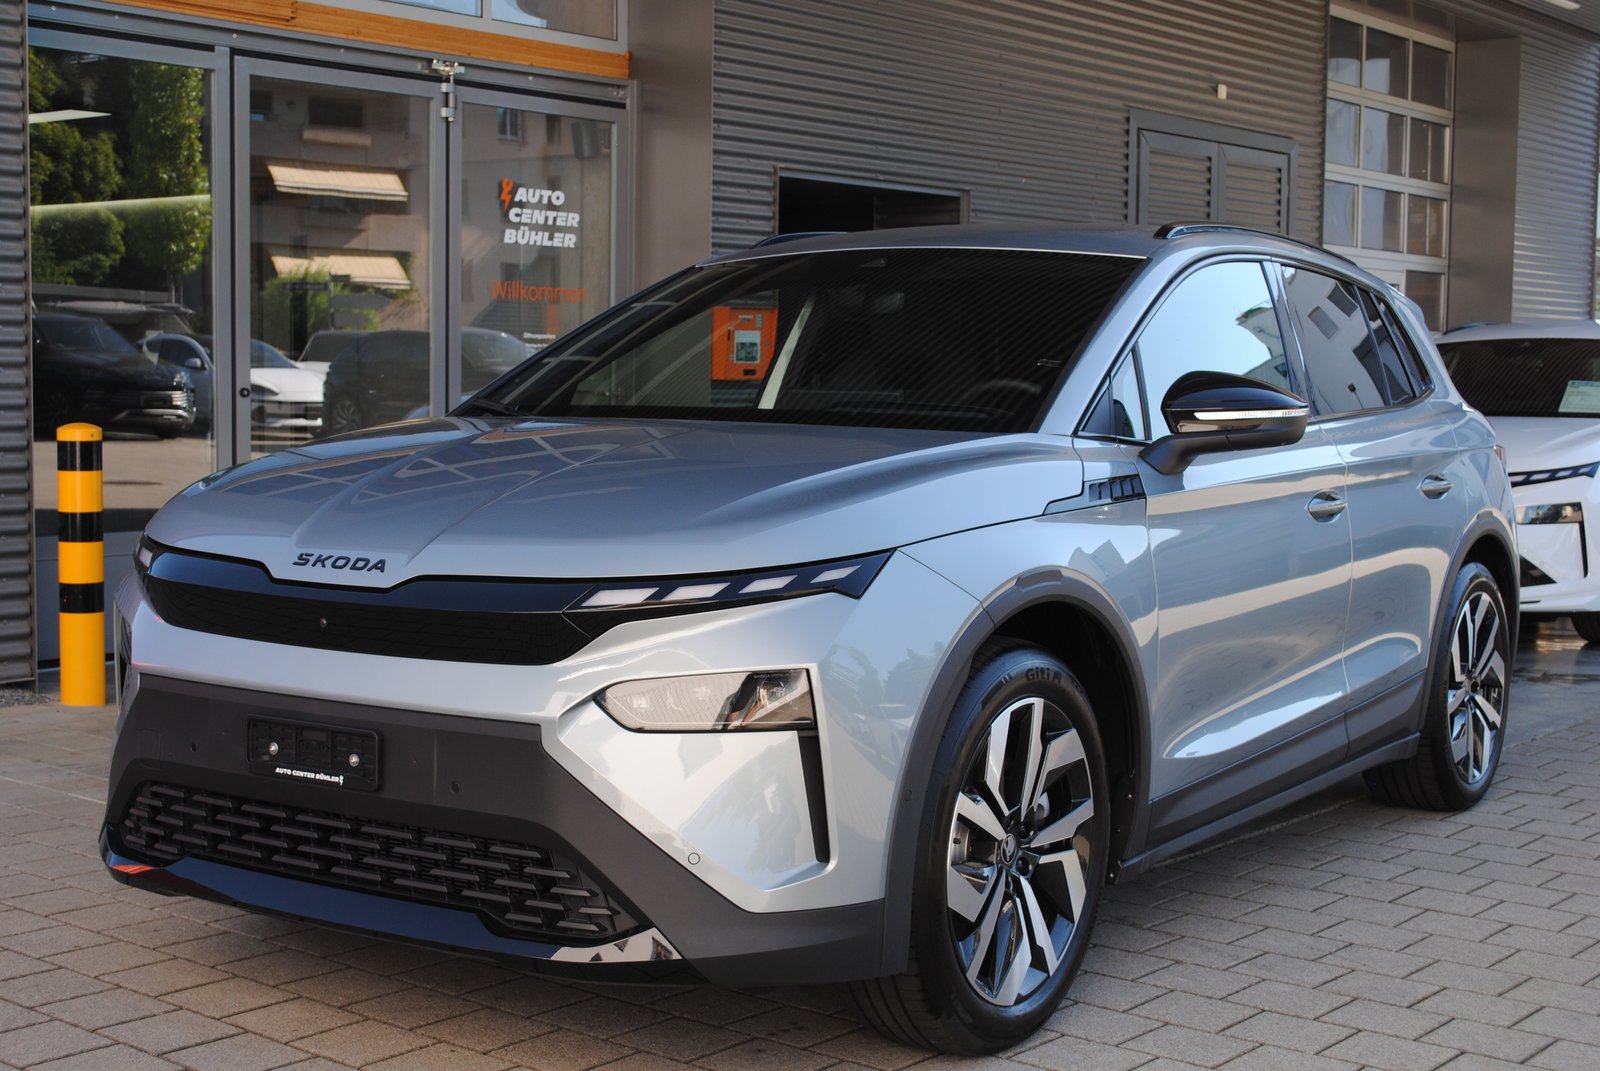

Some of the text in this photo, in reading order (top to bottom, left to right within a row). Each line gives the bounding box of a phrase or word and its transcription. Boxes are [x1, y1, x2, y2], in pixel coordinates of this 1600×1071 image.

[513, 187, 565, 206] AUTO
[508, 207, 580, 228] CENTER
[503, 226, 577, 248] BÜHLER
[490, 279, 588, 304] Willkommen
[275, 767, 339, 782] AUTO CENTER BÜHLER
